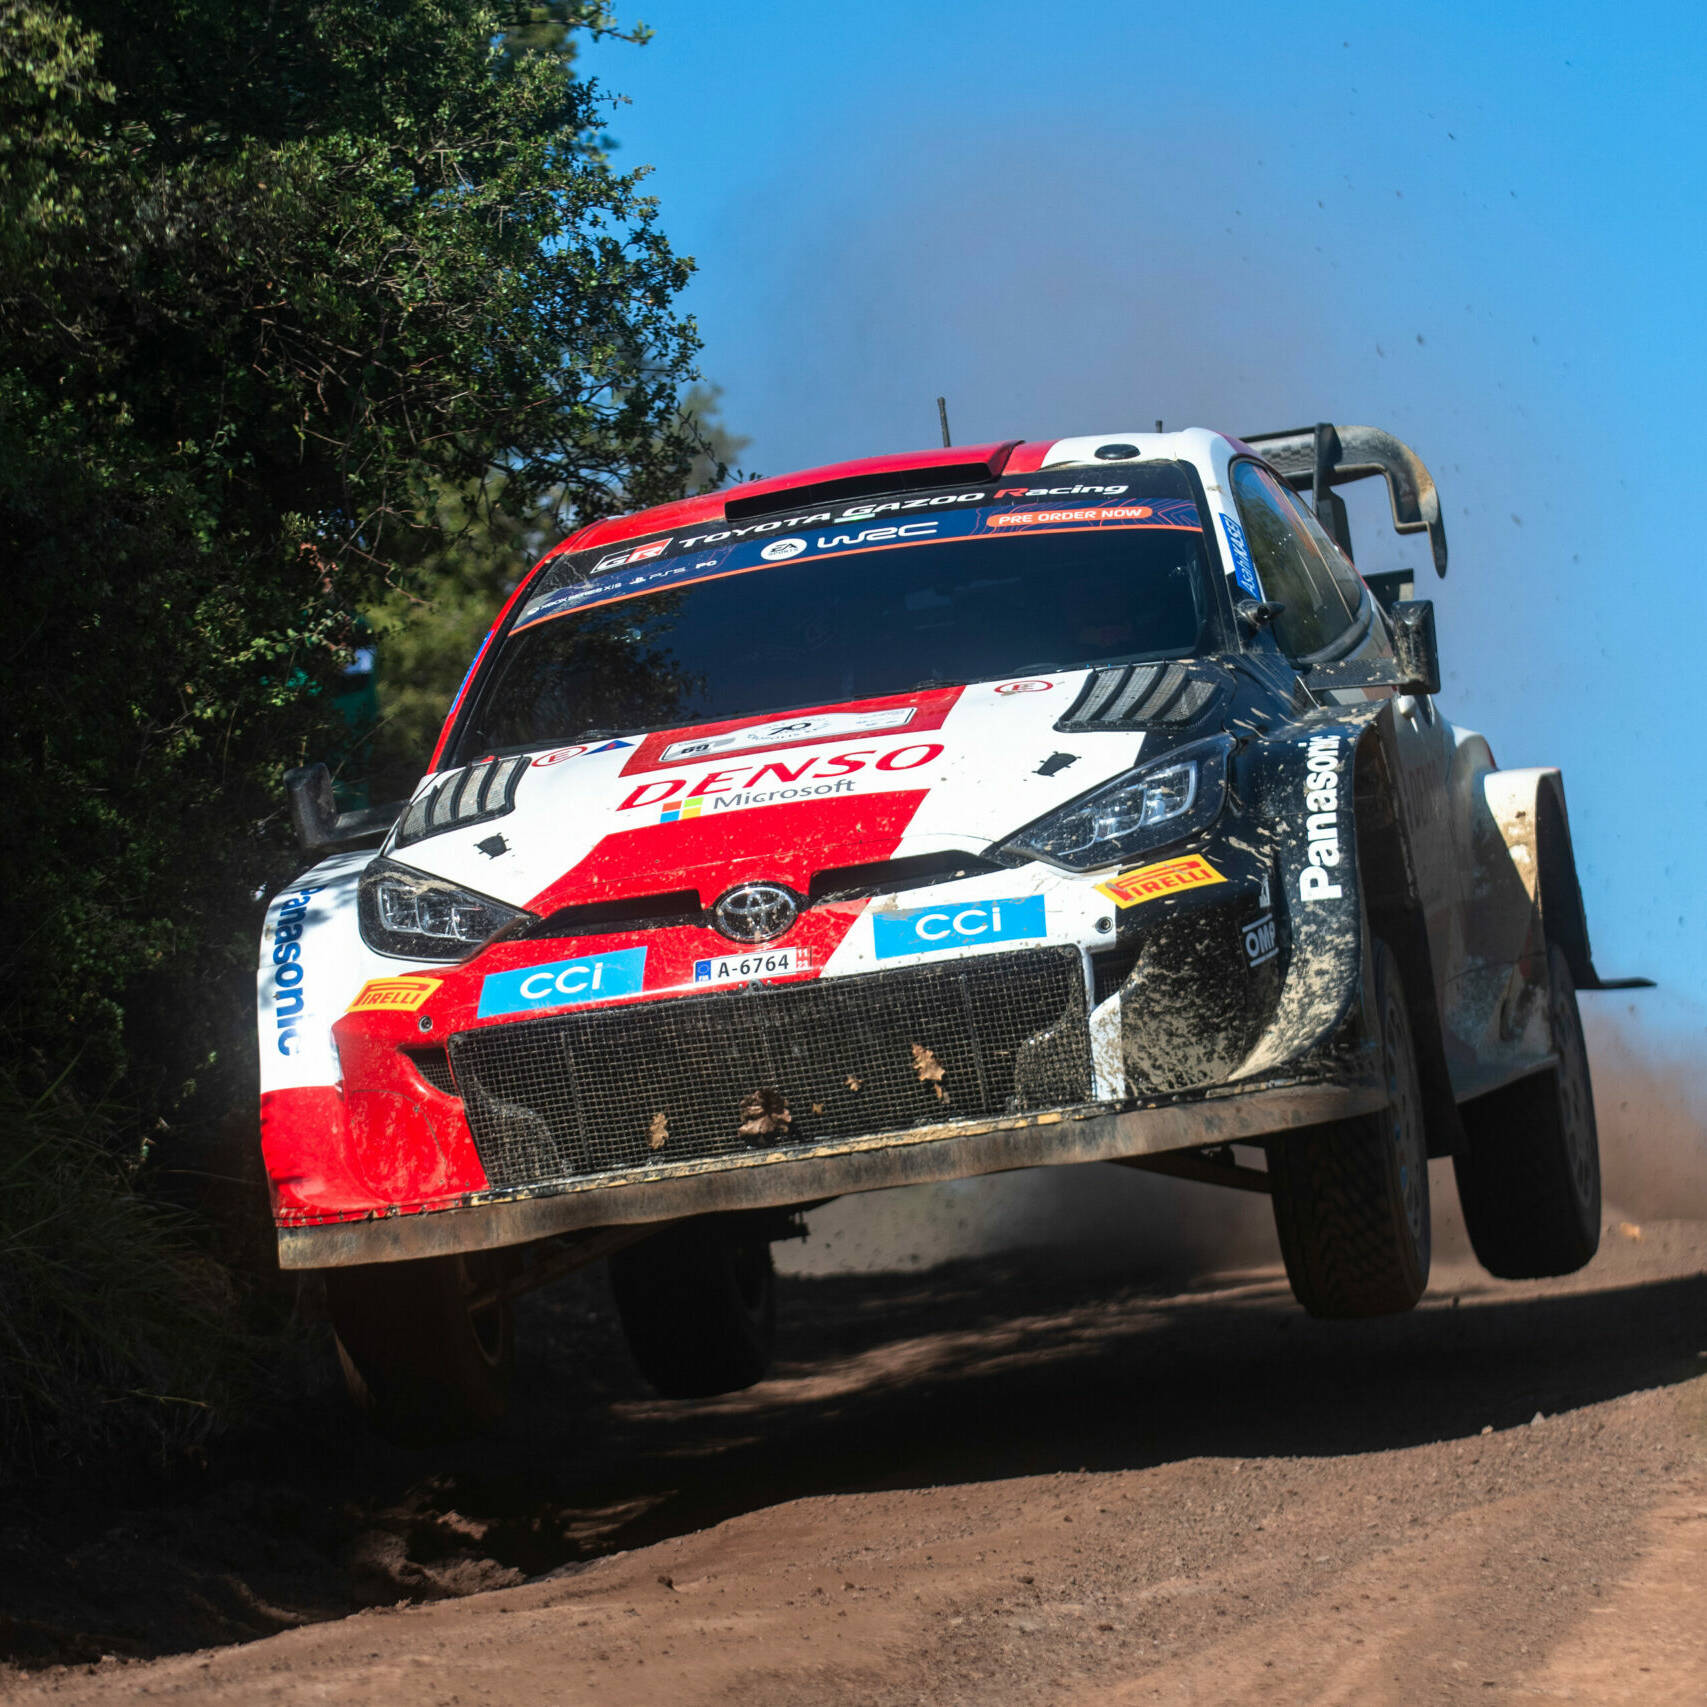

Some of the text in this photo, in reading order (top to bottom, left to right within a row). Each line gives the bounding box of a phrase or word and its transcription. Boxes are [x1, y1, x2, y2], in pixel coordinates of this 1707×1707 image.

[679, 512, 830, 548] TOYOTA
[842, 492, 985, 517] GAZOO
[993, 483, 1129, 499] Racing
[998, 507, 1143, 524] PRE ORDER NOW
[816, 521, 939, 549] WRC
[616, 744, 945, 811] DENSO
[714, 778, 857, 810] Microsoft
[1299, 735, 1343, 902] Panasonic
[1105, 860, 1213, 901] PIRELLI
[1245, 921, 1276, 958] OMP
[273, 884, 328, 1057] Panasonic
[718, 954, 789, 978] A-6764
[351, 982, 431, 1007] PIRELLI
